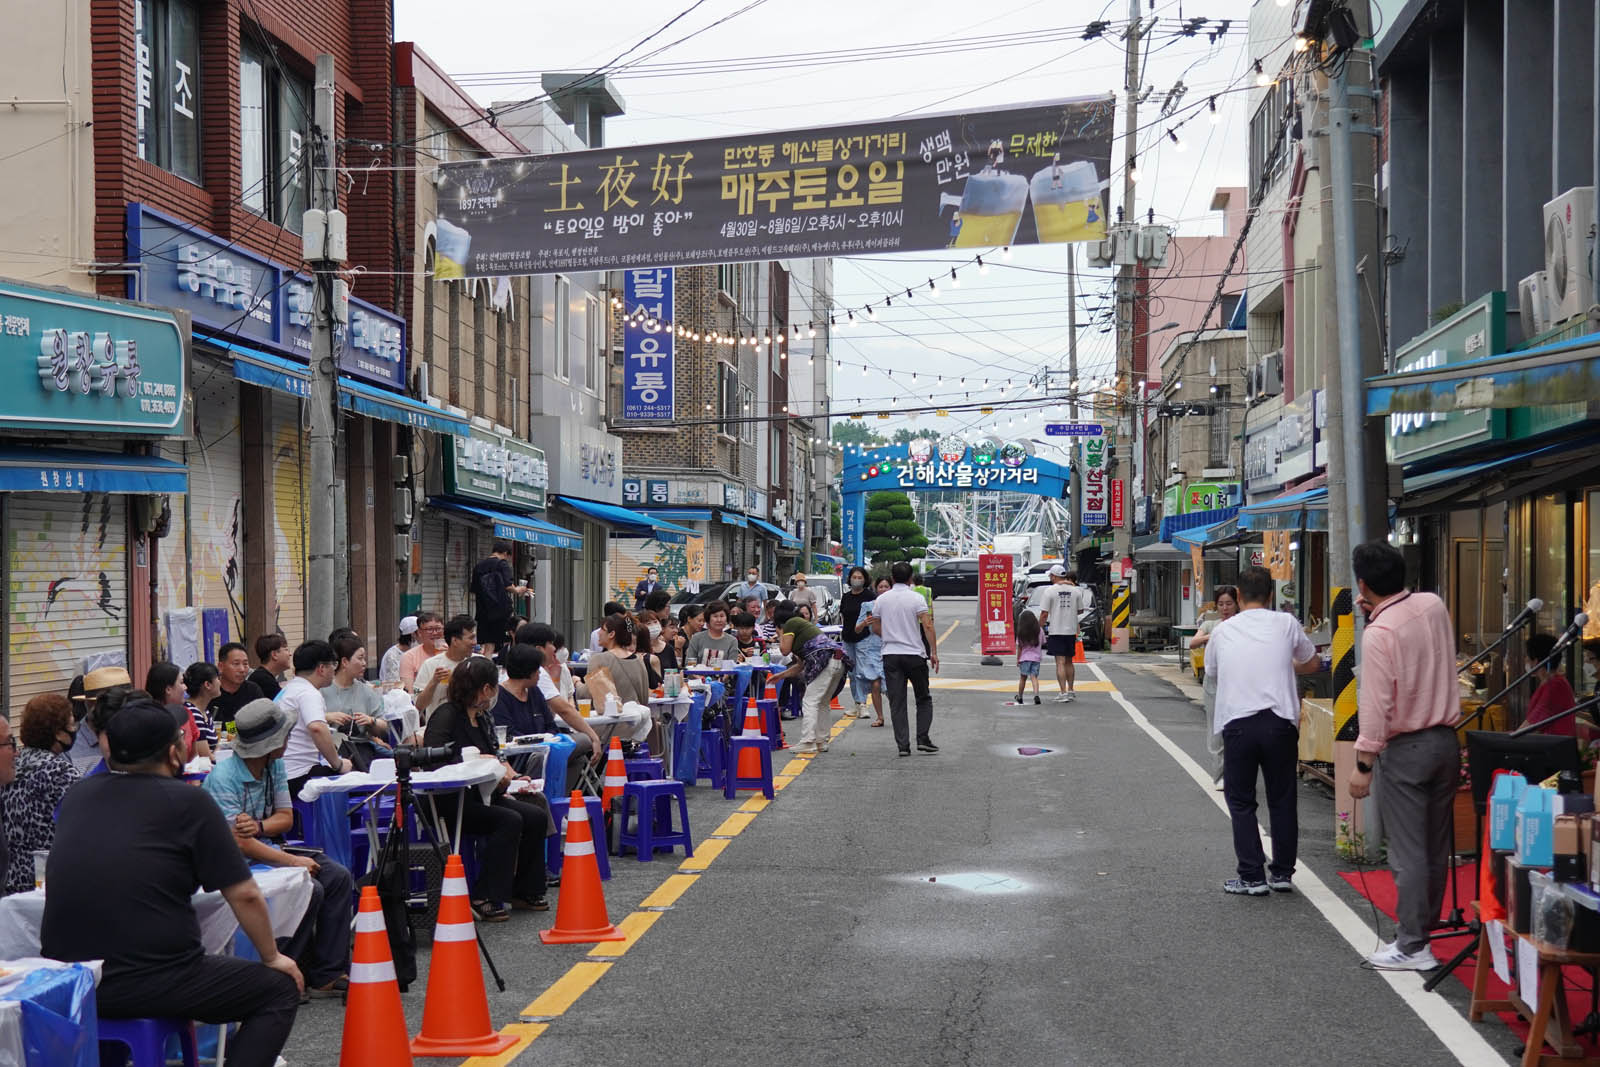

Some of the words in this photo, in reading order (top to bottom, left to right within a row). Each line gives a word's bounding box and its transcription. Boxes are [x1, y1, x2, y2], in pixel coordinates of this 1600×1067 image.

[724, 145, 775, 170] 만호동
[782, 132, 907, 165] 해산물상가거리
[920, 129, 953, 163] 생맥
[1009, 132, 1059, 158] 무제한
[543, 151, 695, 213] 土夜好
[936, 151, 970, 185] 만원
[721, 160, 905, 216] 매주토요일
[613, 214, 645, 235] 밤이
[631, 269, 668, 404] 달성유통
[44, 328, 140, 399] 원창유통
[624, 482, 668, 502] 유통
[897, 463, 1039, 487] 건해산물상가거리
[985, 572, 1008, 583] 토요일
